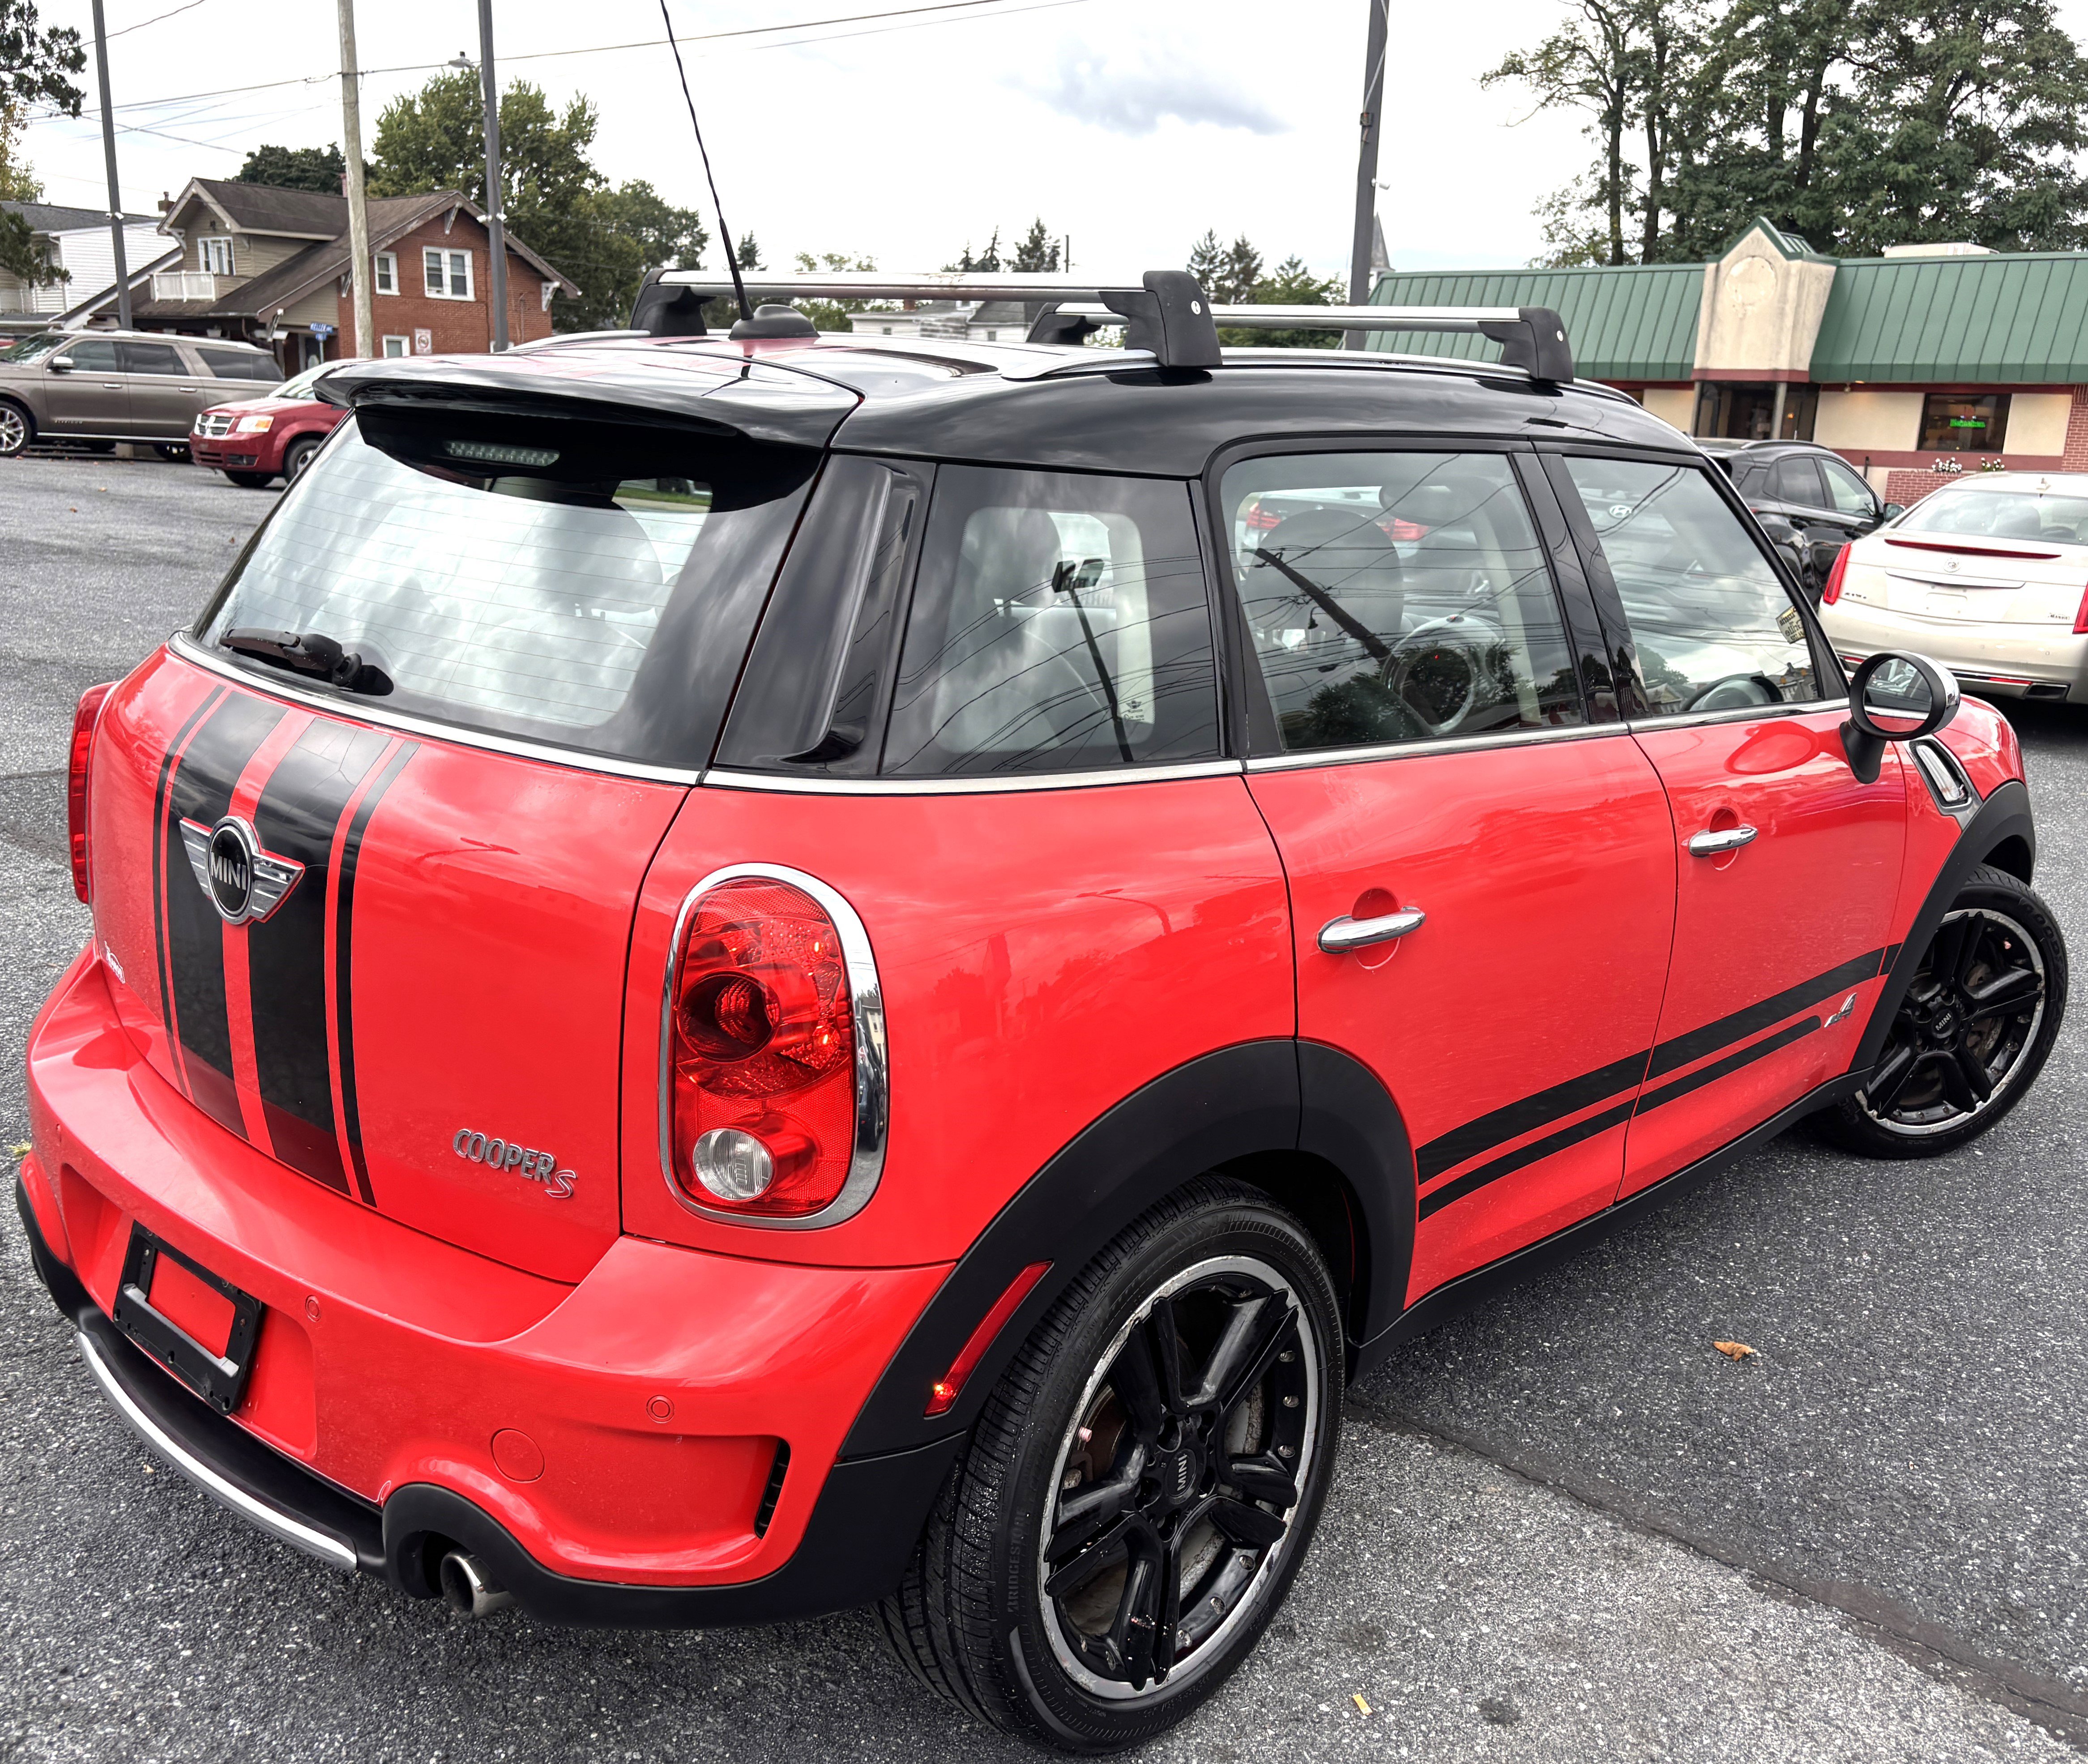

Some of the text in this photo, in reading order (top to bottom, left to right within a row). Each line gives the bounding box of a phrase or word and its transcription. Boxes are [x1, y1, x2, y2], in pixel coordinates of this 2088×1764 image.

[211, 852, 247, 890] MINI
[1935, 1013, 1951, 1030] MINI
[453, 1128, 577, 1198] COOPER S
[1177, 1454, 1187, 1491] MINI
